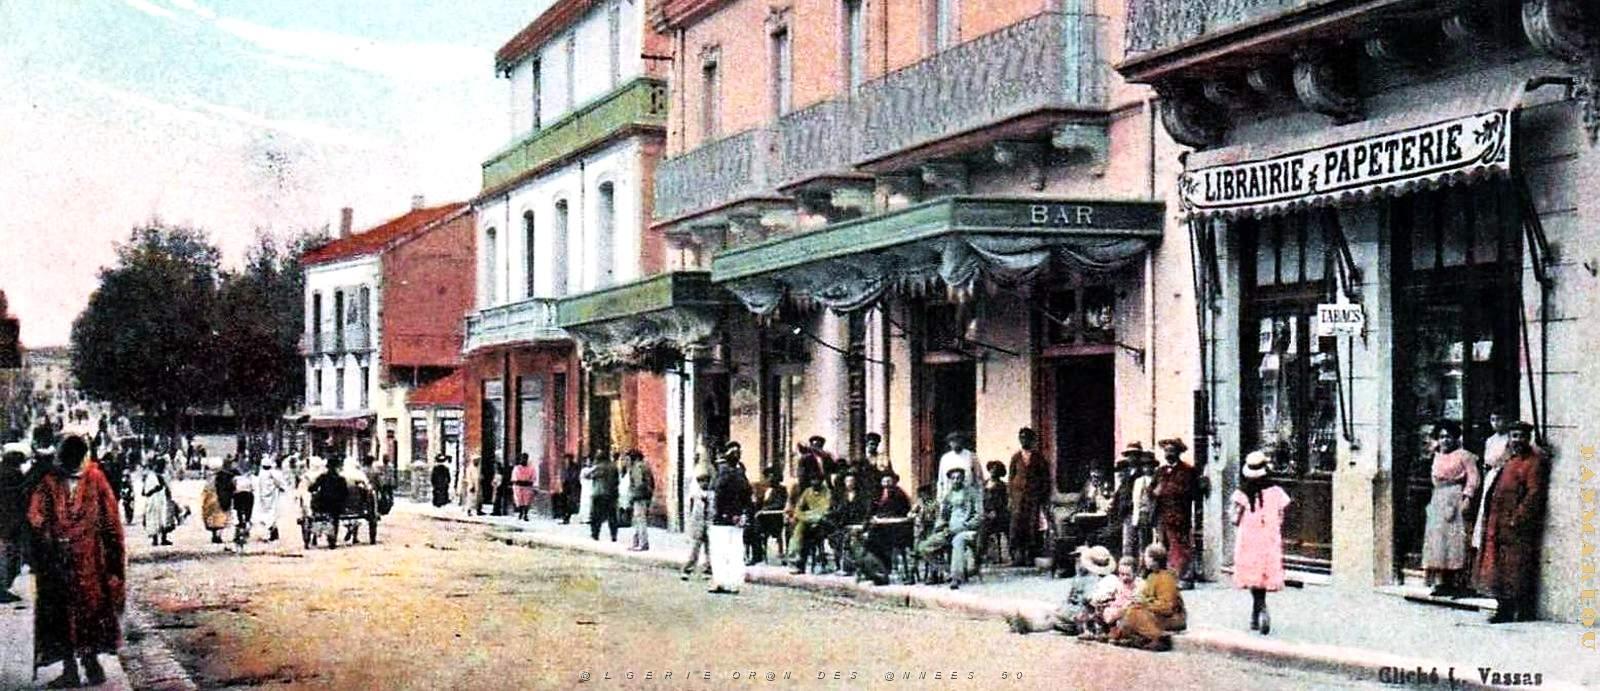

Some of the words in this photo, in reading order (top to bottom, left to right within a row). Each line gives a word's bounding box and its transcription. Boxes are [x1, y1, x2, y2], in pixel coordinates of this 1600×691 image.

[1204, 158, 1303, 201] LIBRAIRIE
[1324, 124, 1463, 185] PAPETERIE
[1031, 204, 1093, 224] BAR
[1320, 309, 1361, 323] TABACS
